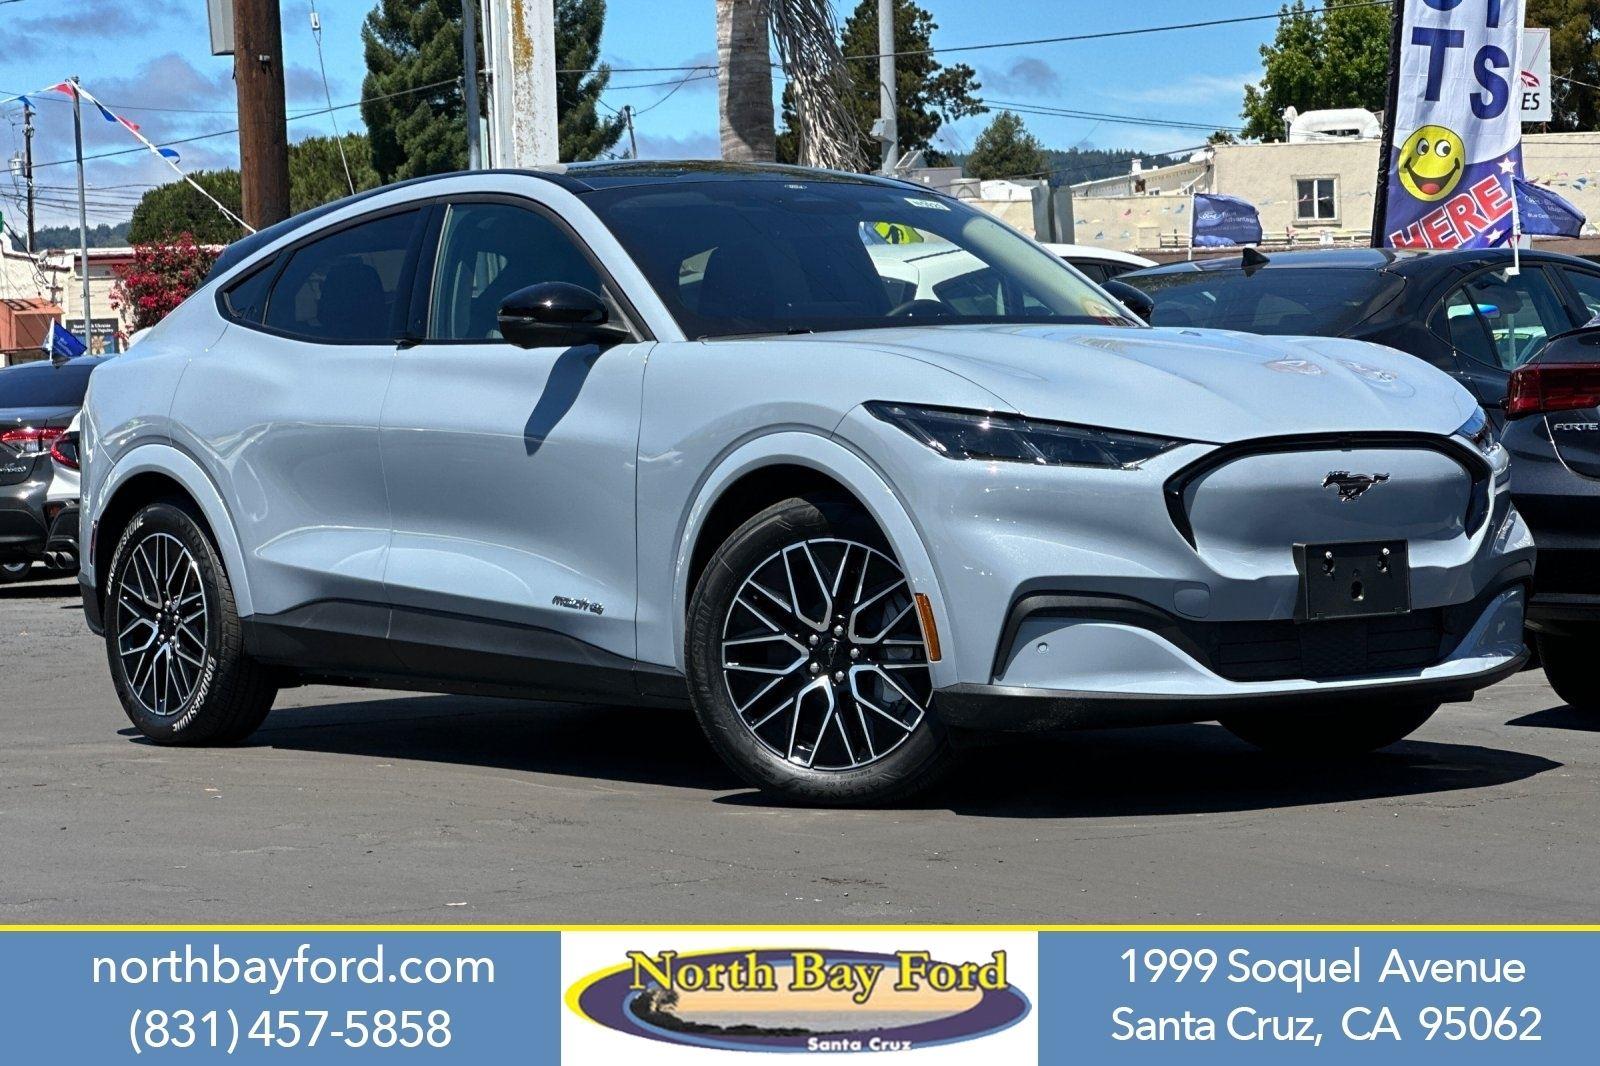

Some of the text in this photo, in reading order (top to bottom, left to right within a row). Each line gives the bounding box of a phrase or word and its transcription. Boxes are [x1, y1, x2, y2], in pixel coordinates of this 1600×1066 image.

[1389, 174, 1513, 249] HERE
[1553, 422, 1599, 431] FORTE
[172, 654, 217, 732] BRIDGESTONE
